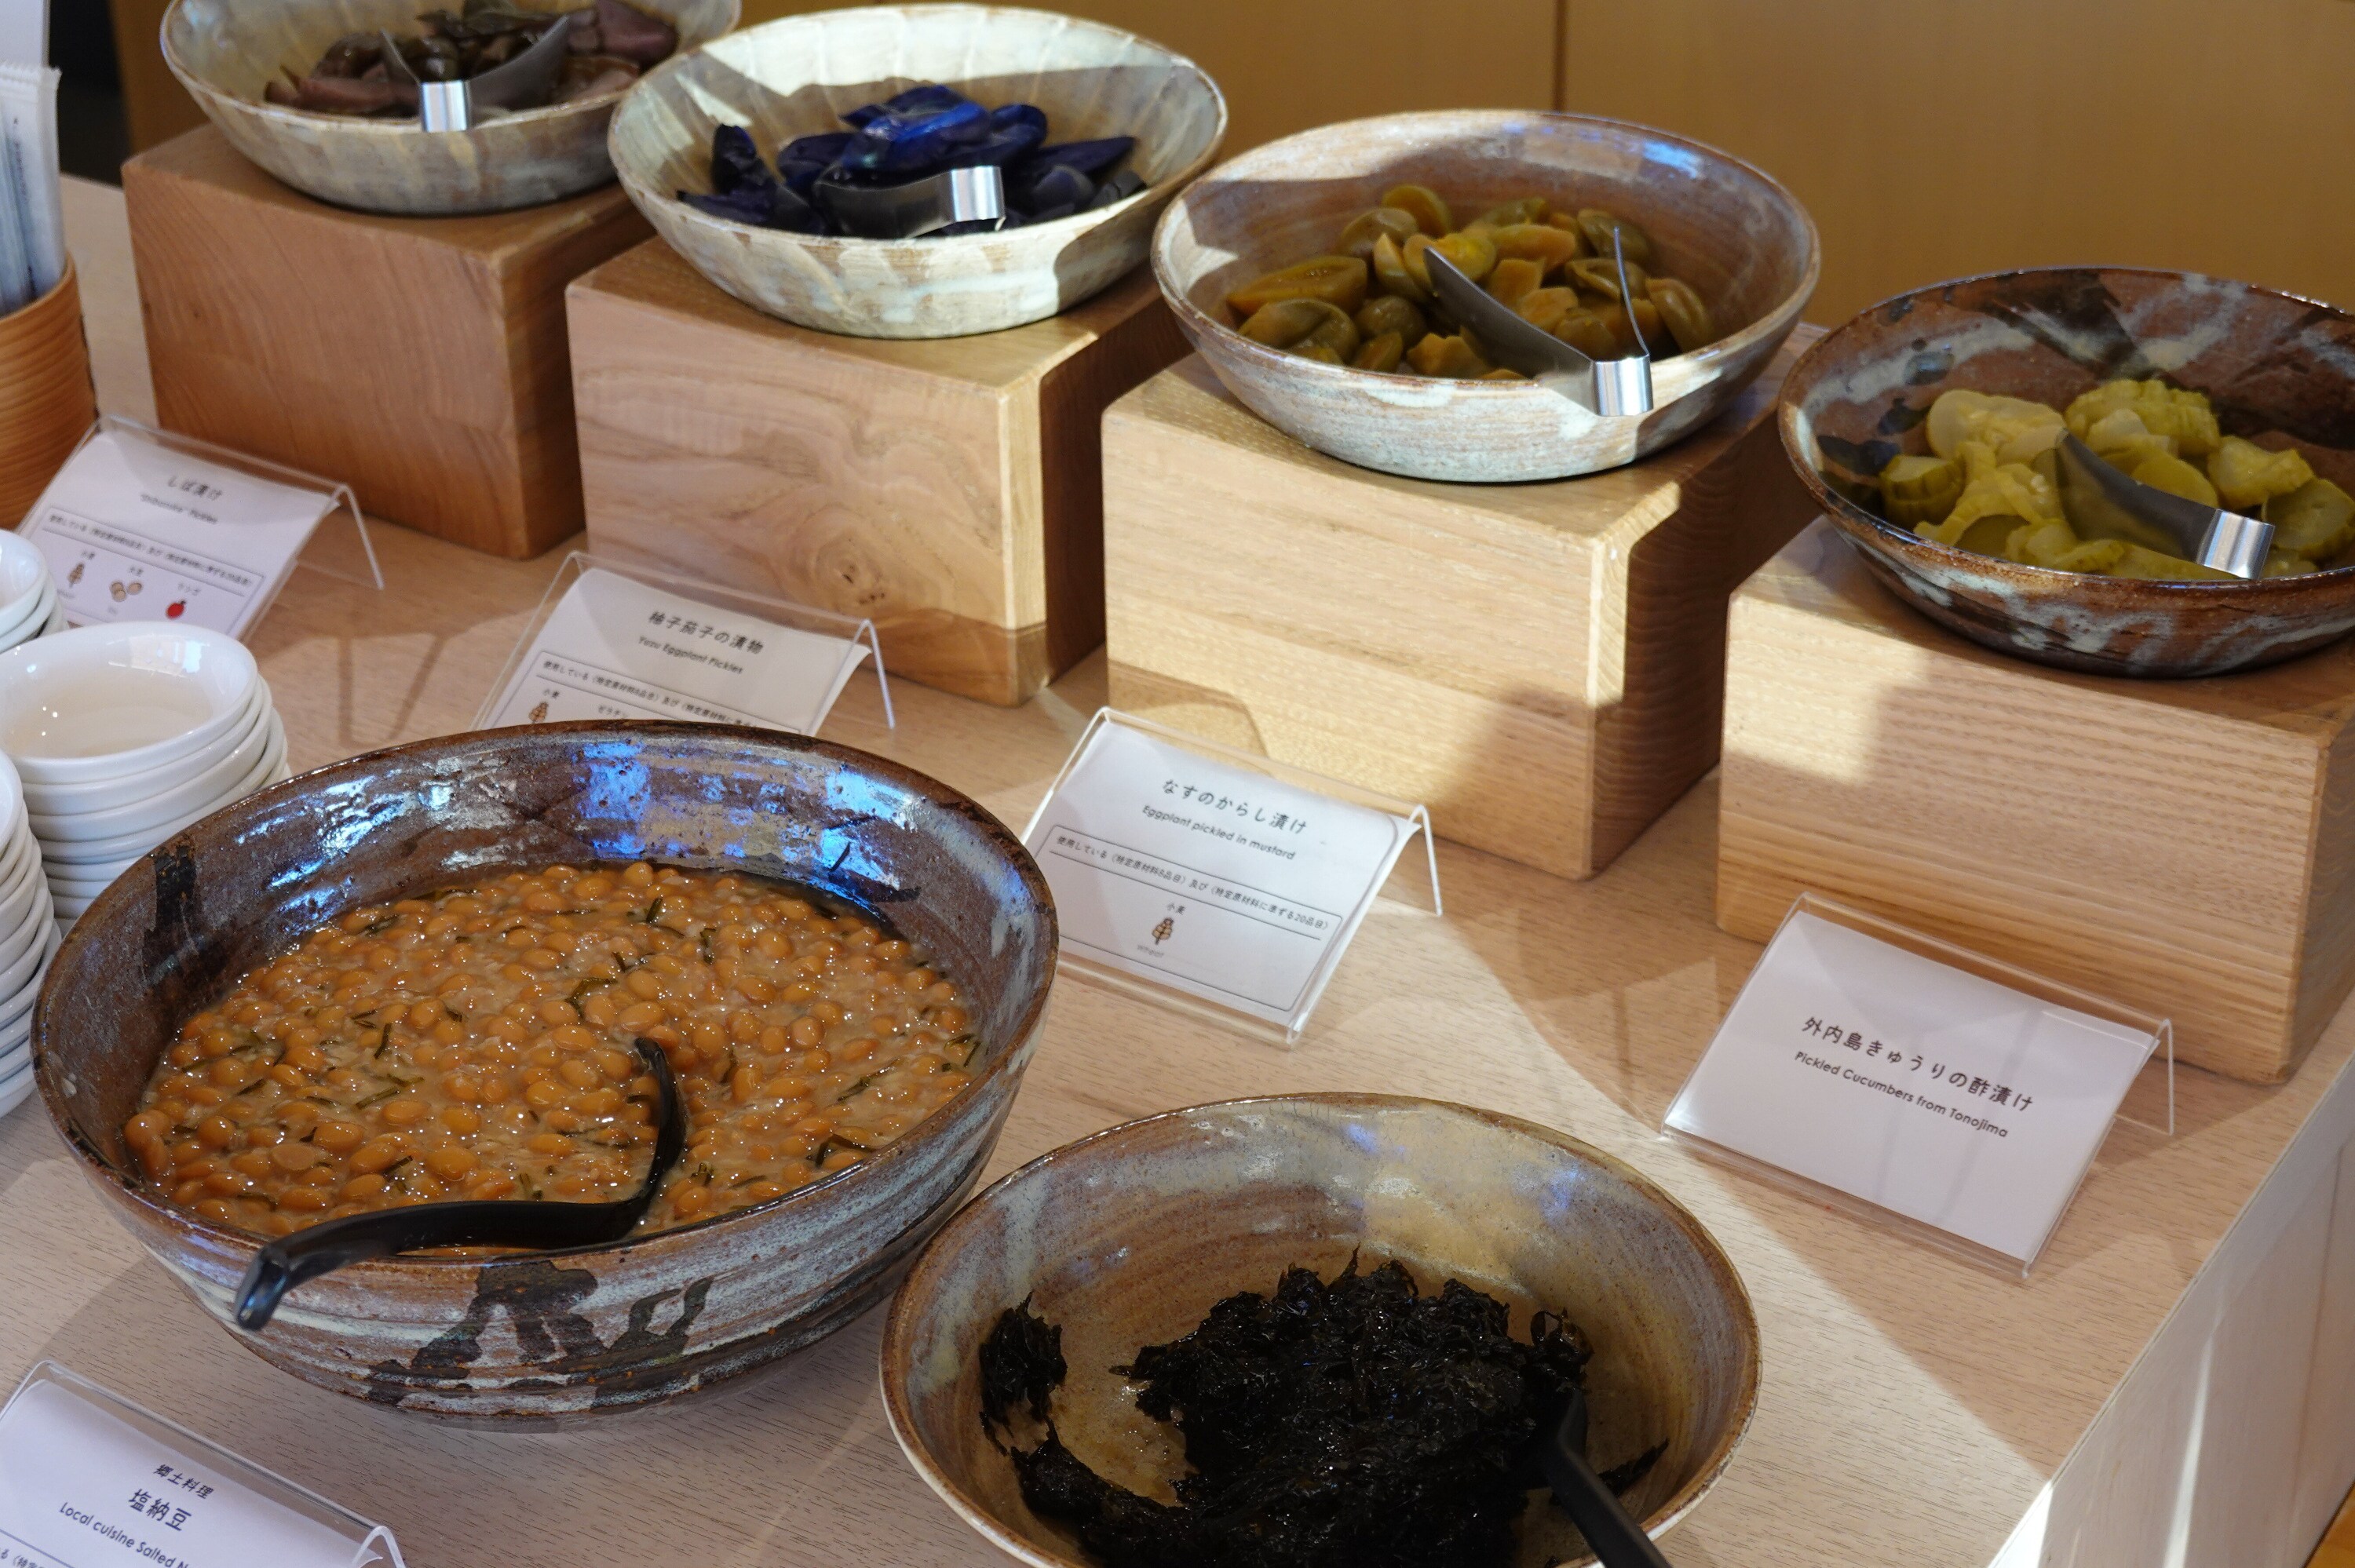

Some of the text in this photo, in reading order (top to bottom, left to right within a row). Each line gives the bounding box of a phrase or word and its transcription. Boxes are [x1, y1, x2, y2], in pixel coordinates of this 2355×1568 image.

[1142, 805, 1295, 860] Eggplant pickled in mustard
[1163, 779, 1307, 834] なすのからし漬け
[1802, 1016, 2033, 1111] 外内島きゅうりの酢漬け
[1795, 1051, 2008, 1138] Pickled Cucumbers from Tonojima
[154, 1464, 214, 1499] 郷土料理
[59, 1502, 94, 1526] Local
[93, 1520, 135, 1548] cuisine
[136, 1541, 176, 1567] Salted
[129, 1489, 192, 1531] 塩納豆
